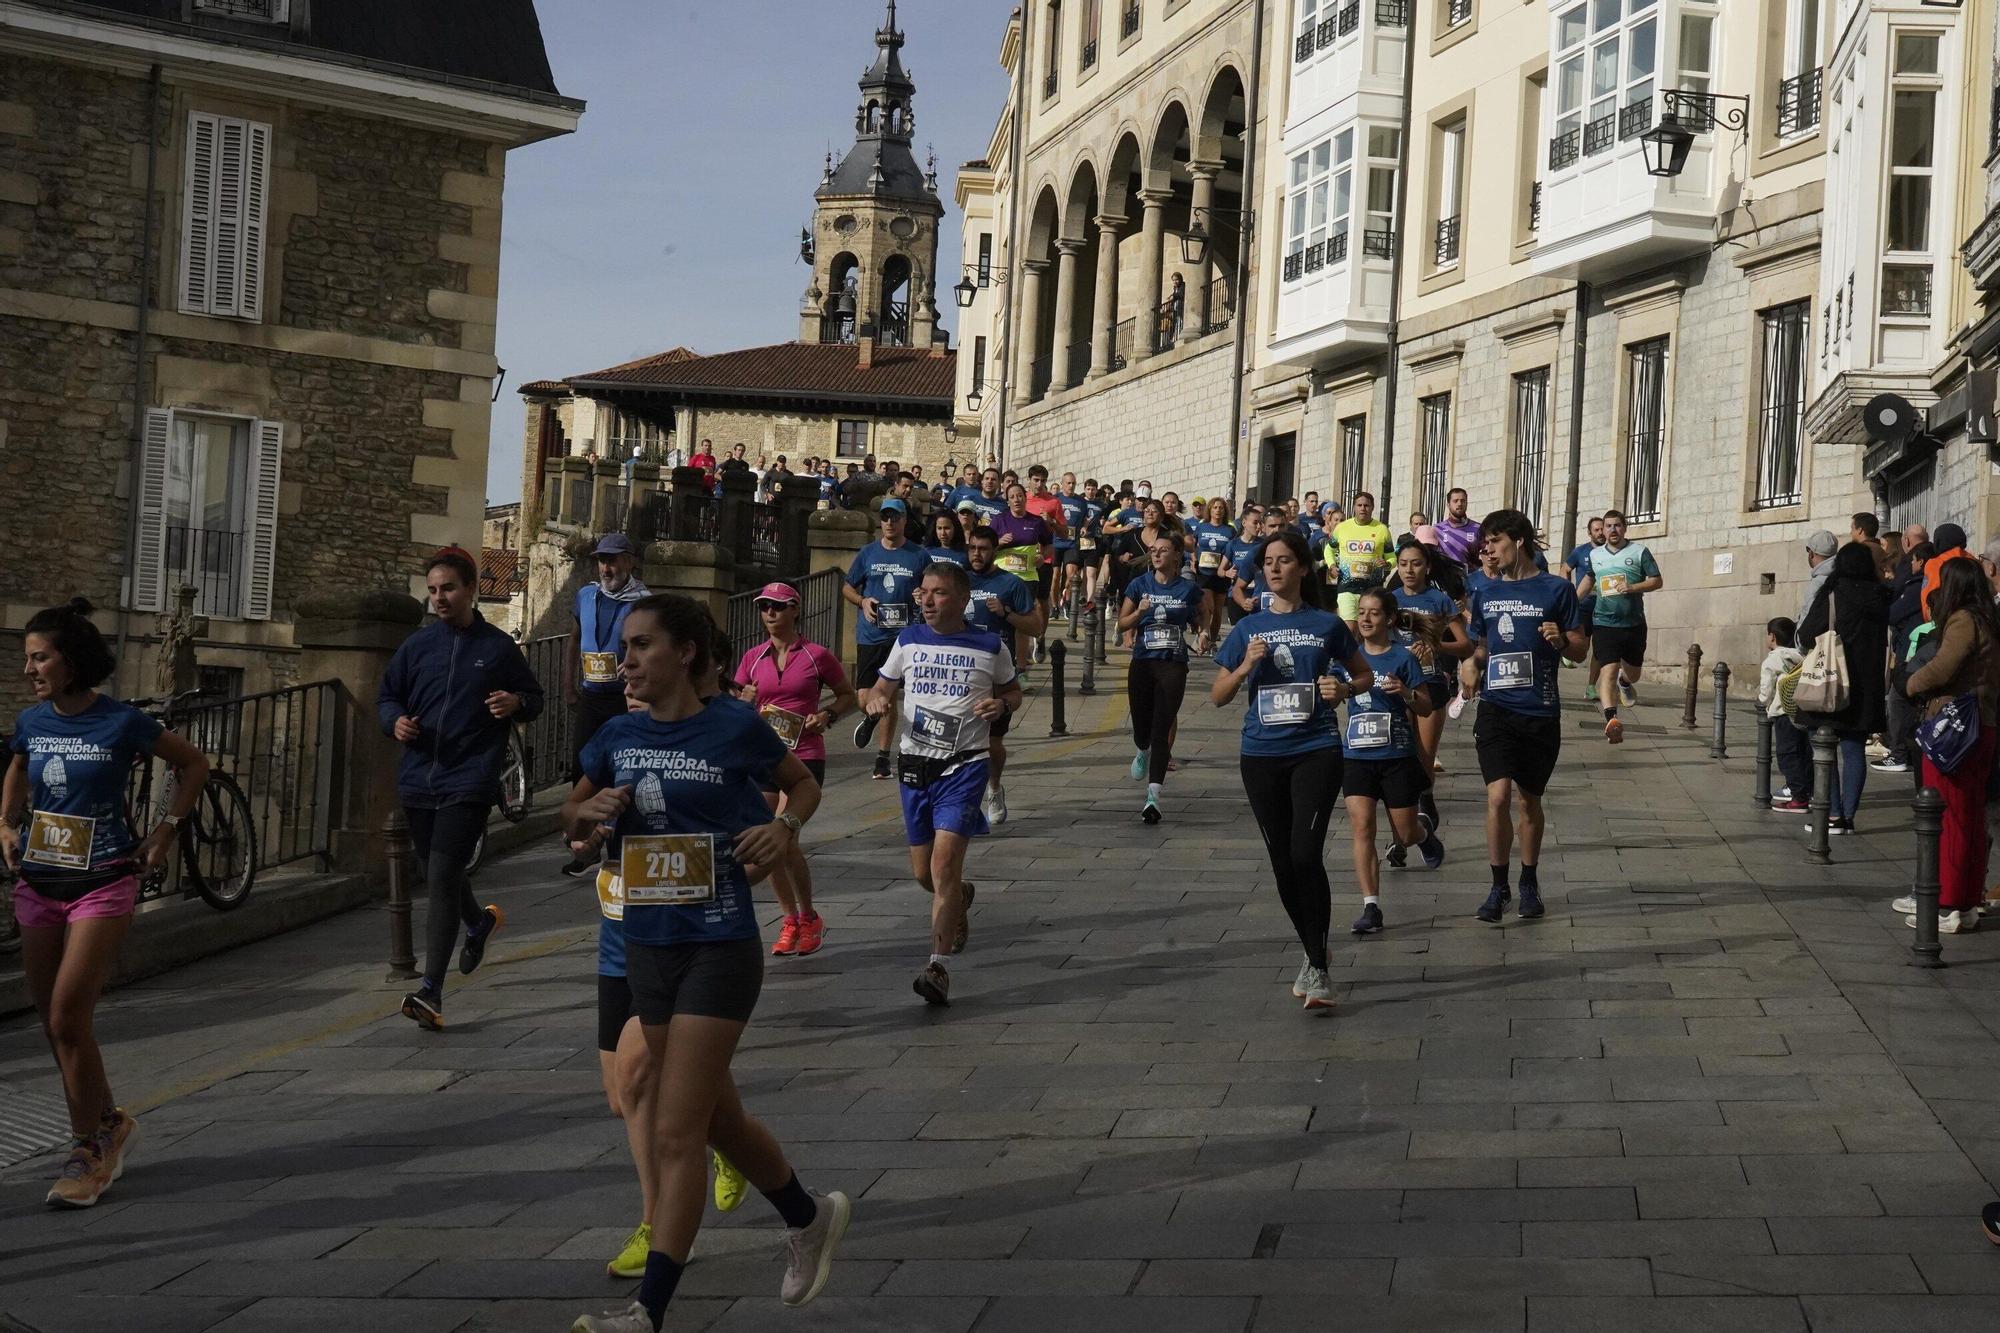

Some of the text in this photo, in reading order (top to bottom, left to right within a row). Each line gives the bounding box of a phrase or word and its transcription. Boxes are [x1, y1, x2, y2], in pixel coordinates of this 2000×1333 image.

[884, 609, 900, 619] 783
[1489, 604, 1535, 612] ALMENDRA
[1258, 628, 1300, 638] CONQUISTA
[1289, 640, 1325, 648] KONKISTA
[590, 660, 606, 671] 123
[933, 653, 976, 668] ALEGRIA
[913, 666, 971, 682] ALEVIN F. 7
[1498, 661, 1519, 676] 914
[911, 682, 971, 697] 2008-2009
[1273, 693, 1300, 709] 944
[922, 716, 946, 736] 745
[1358, 721, 1377, 734] 815
[35, 736, 83, 745] CONQUISTA
[34, 744, 100, 754] ALMENDRA
[613, 748, 685, 760] LA CONQUISTA
[65, 753, 113, 761] KONKISTA
[621, 757, 709, 772] ALMENDRA
[663, 770, 724, 784] KONKISTA
[43, 825, 72, 848] 102
[646, 852, 686, 878] 279
